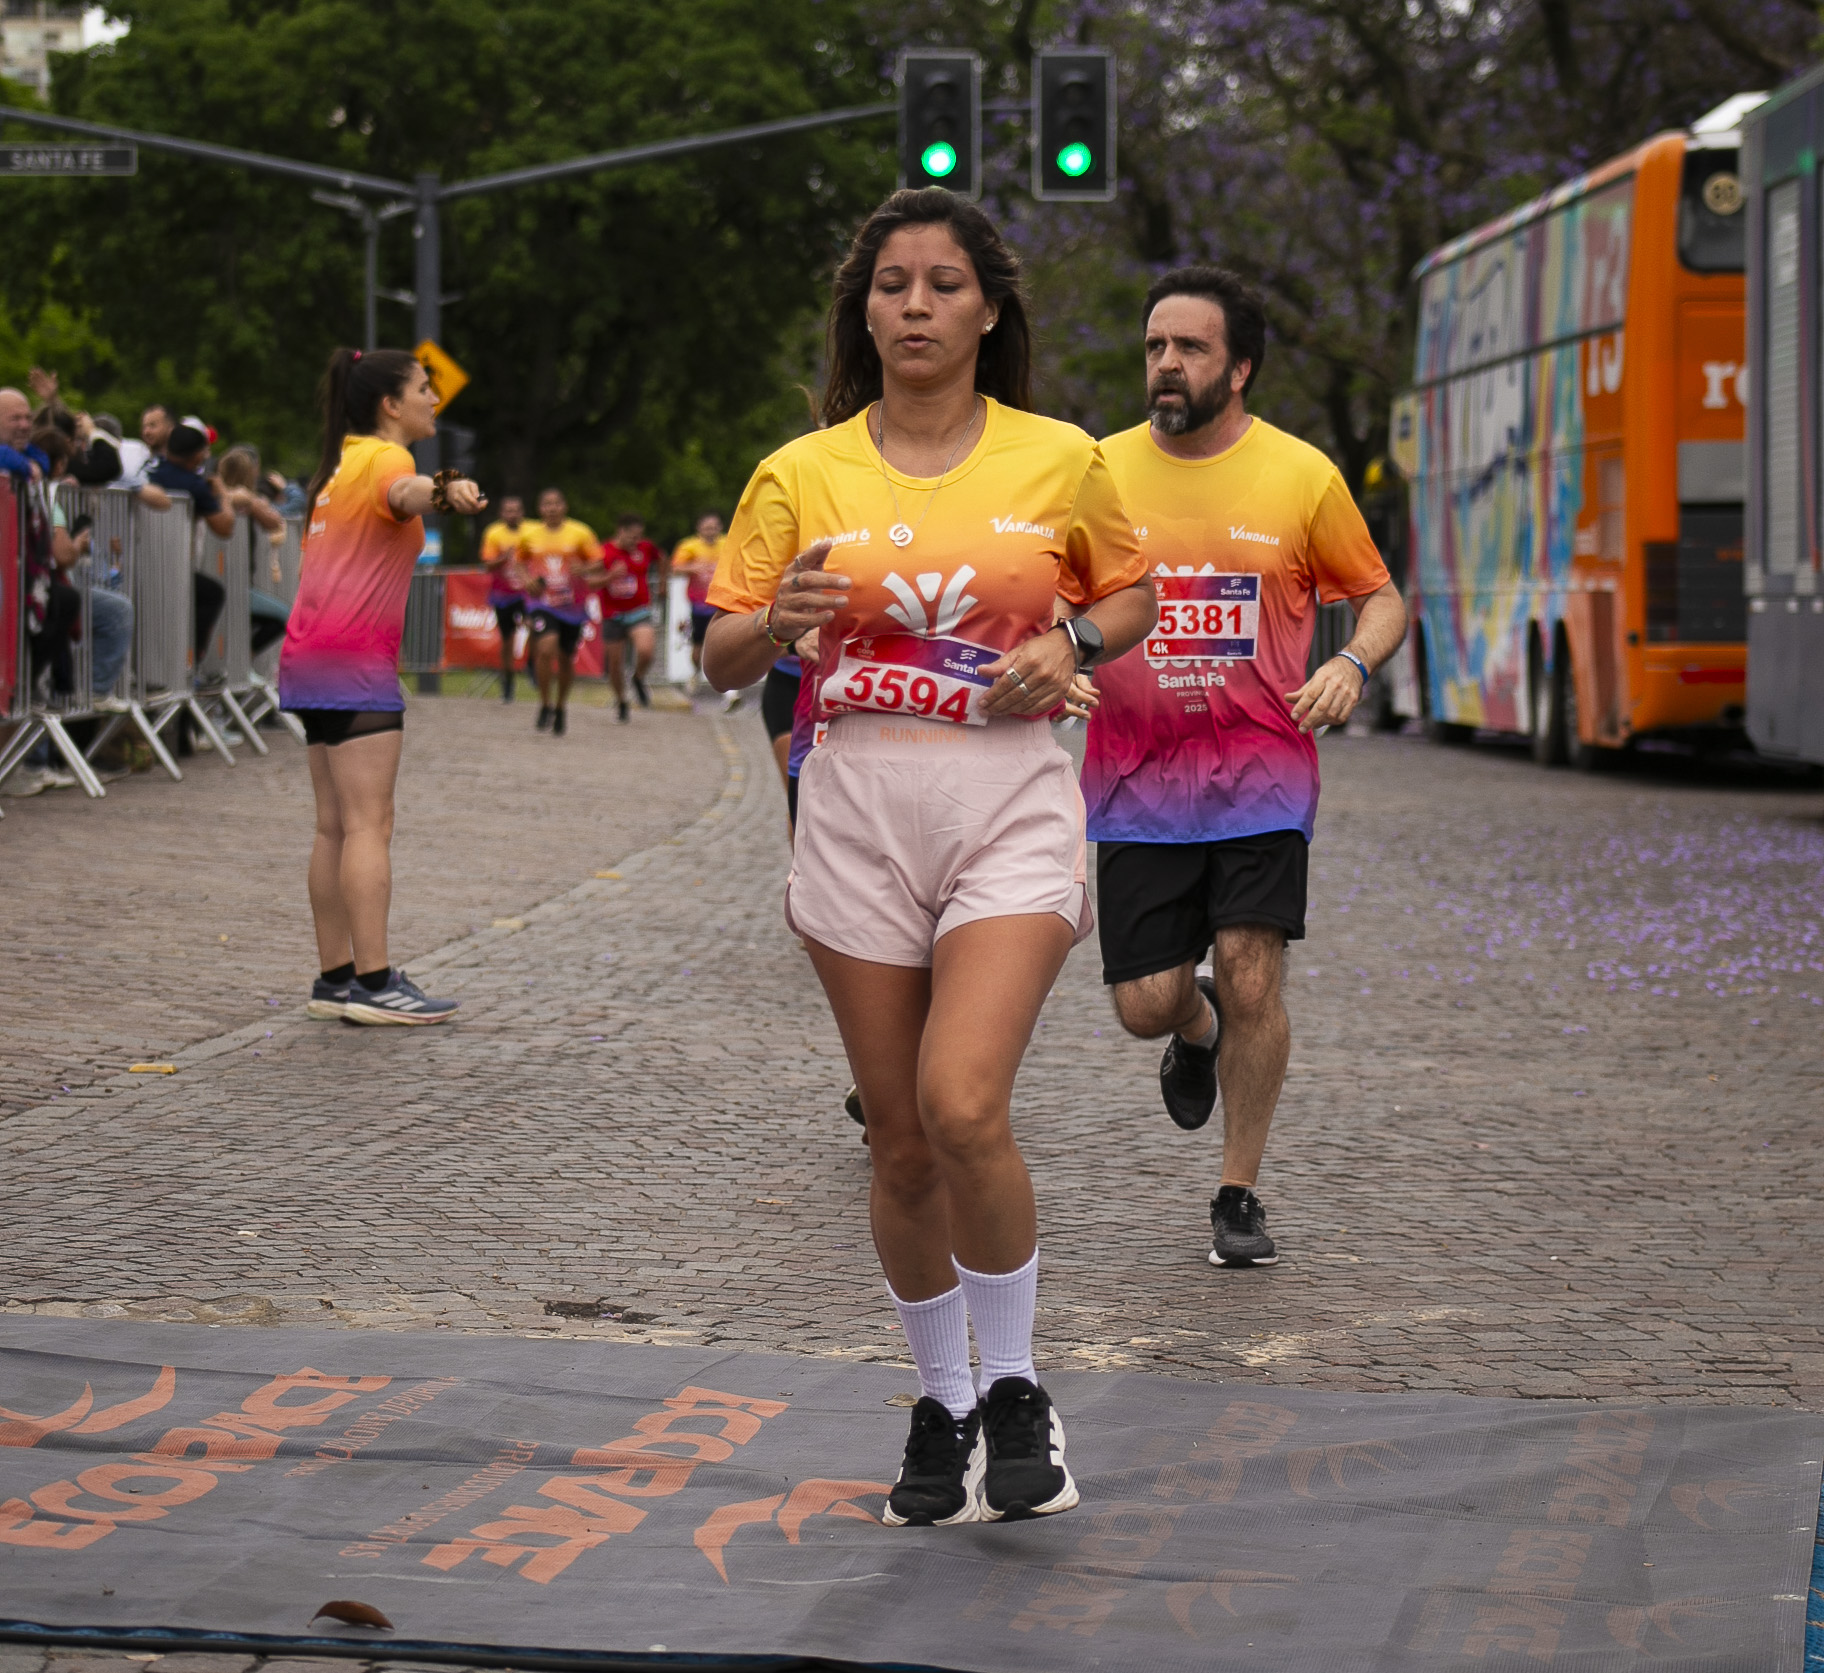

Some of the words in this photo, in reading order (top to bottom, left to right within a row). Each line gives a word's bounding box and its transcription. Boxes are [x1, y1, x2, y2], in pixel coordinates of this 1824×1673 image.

[10, 151, 76, 171] SANTA
[79, 151, 105, 171] FE
[859, 528, 871, 541] 6
[989, 513, 1055, 540] VANDALIA
[1228, 524, 1280, 546] VANDALIA
[1220, 588, 1241, 596] Santa
[1242, 588, 1251, 596] Fe
[1158, 604, 1242, 636] 5381
[1151, 642, 1169, 655] 4k
[943, 658, 974, 675] Santa
[1157, 673, 1206, 689] Santa
[1206, 672, 1226, 687] Fe
[844, 666, 972, 724] 5594
[1184, 703, 1208, 713] 2025
[879, 725, 968, 744] RUNNING
